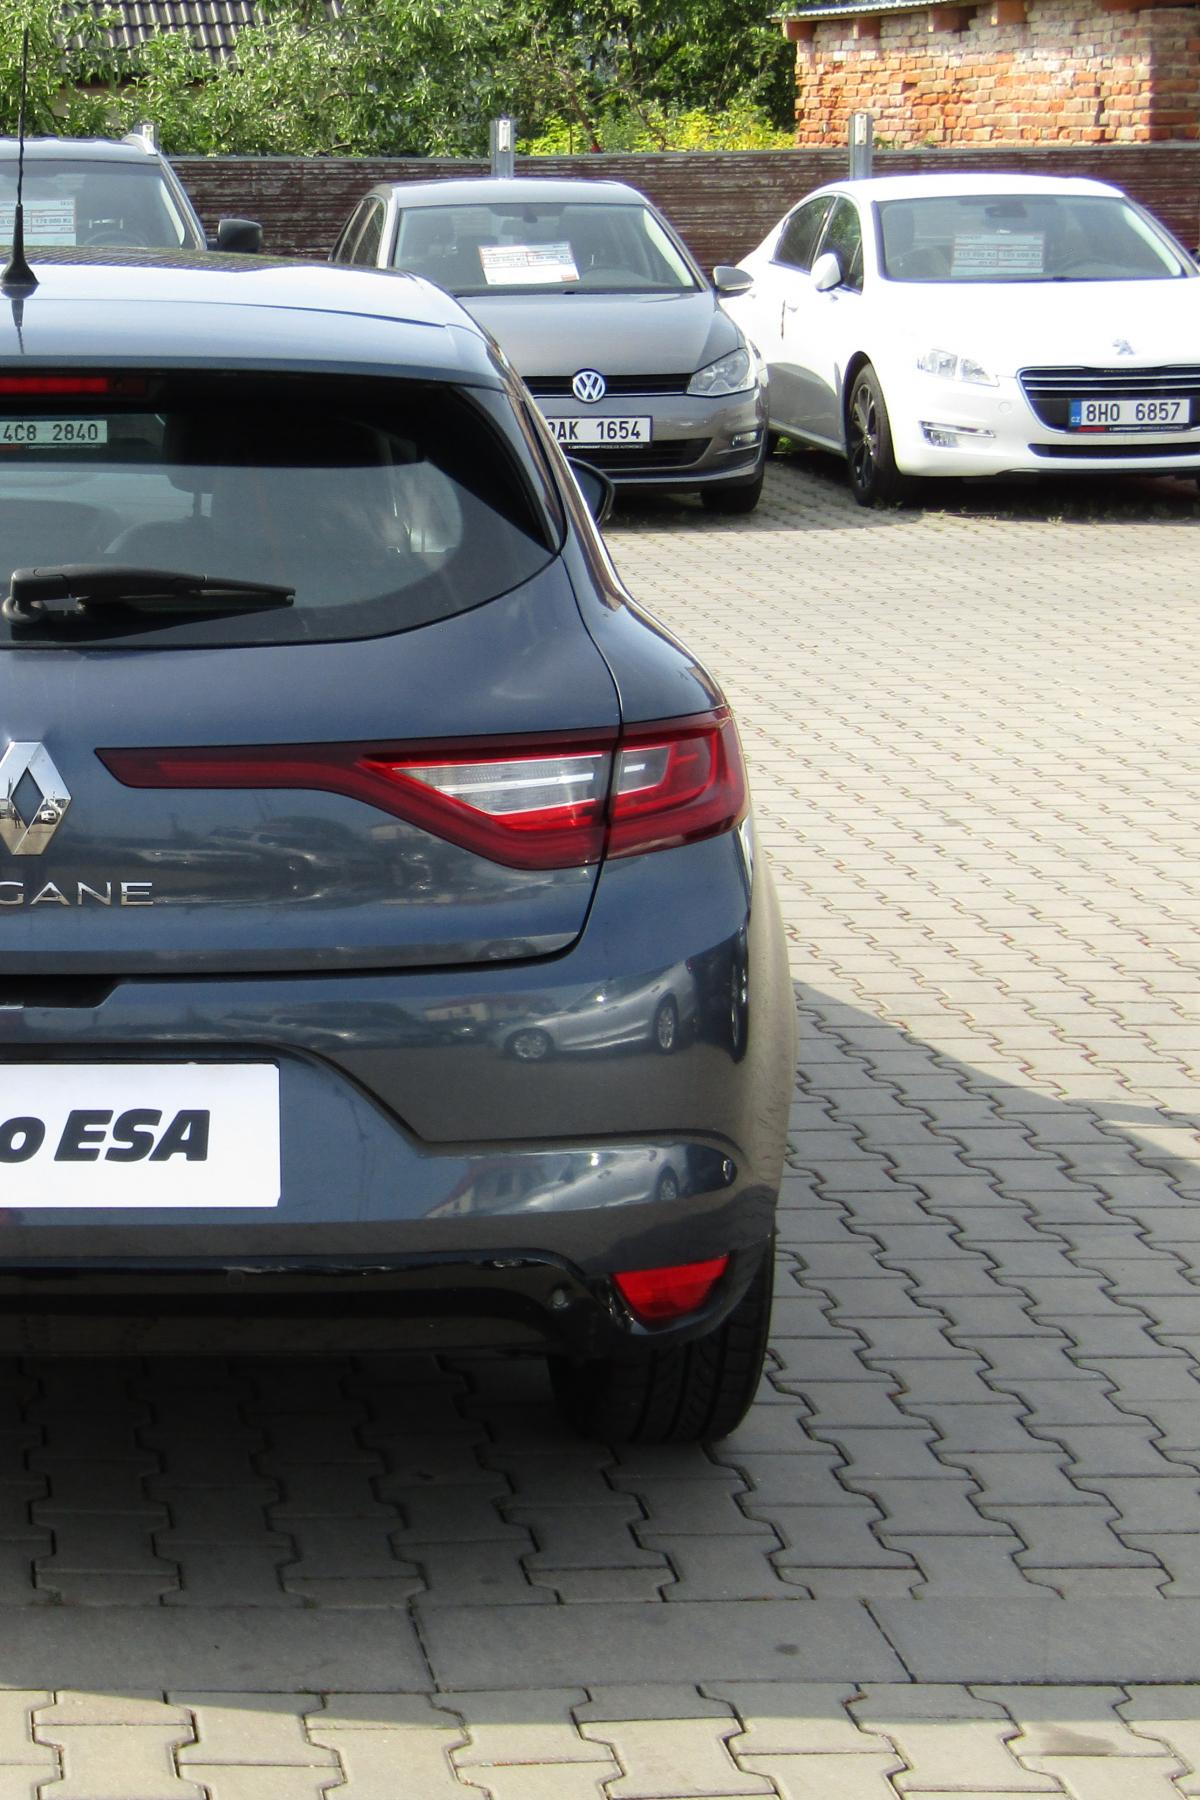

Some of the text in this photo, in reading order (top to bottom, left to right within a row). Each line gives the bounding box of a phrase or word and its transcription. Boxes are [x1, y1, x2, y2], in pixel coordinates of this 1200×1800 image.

[1086, 402, 1181, 422] 8H0 6857
[3, 423, 98, 441] 4C8 2840
[596, 420, 641, 440] 1654
[53, 1108, 210, 1162] ESA
